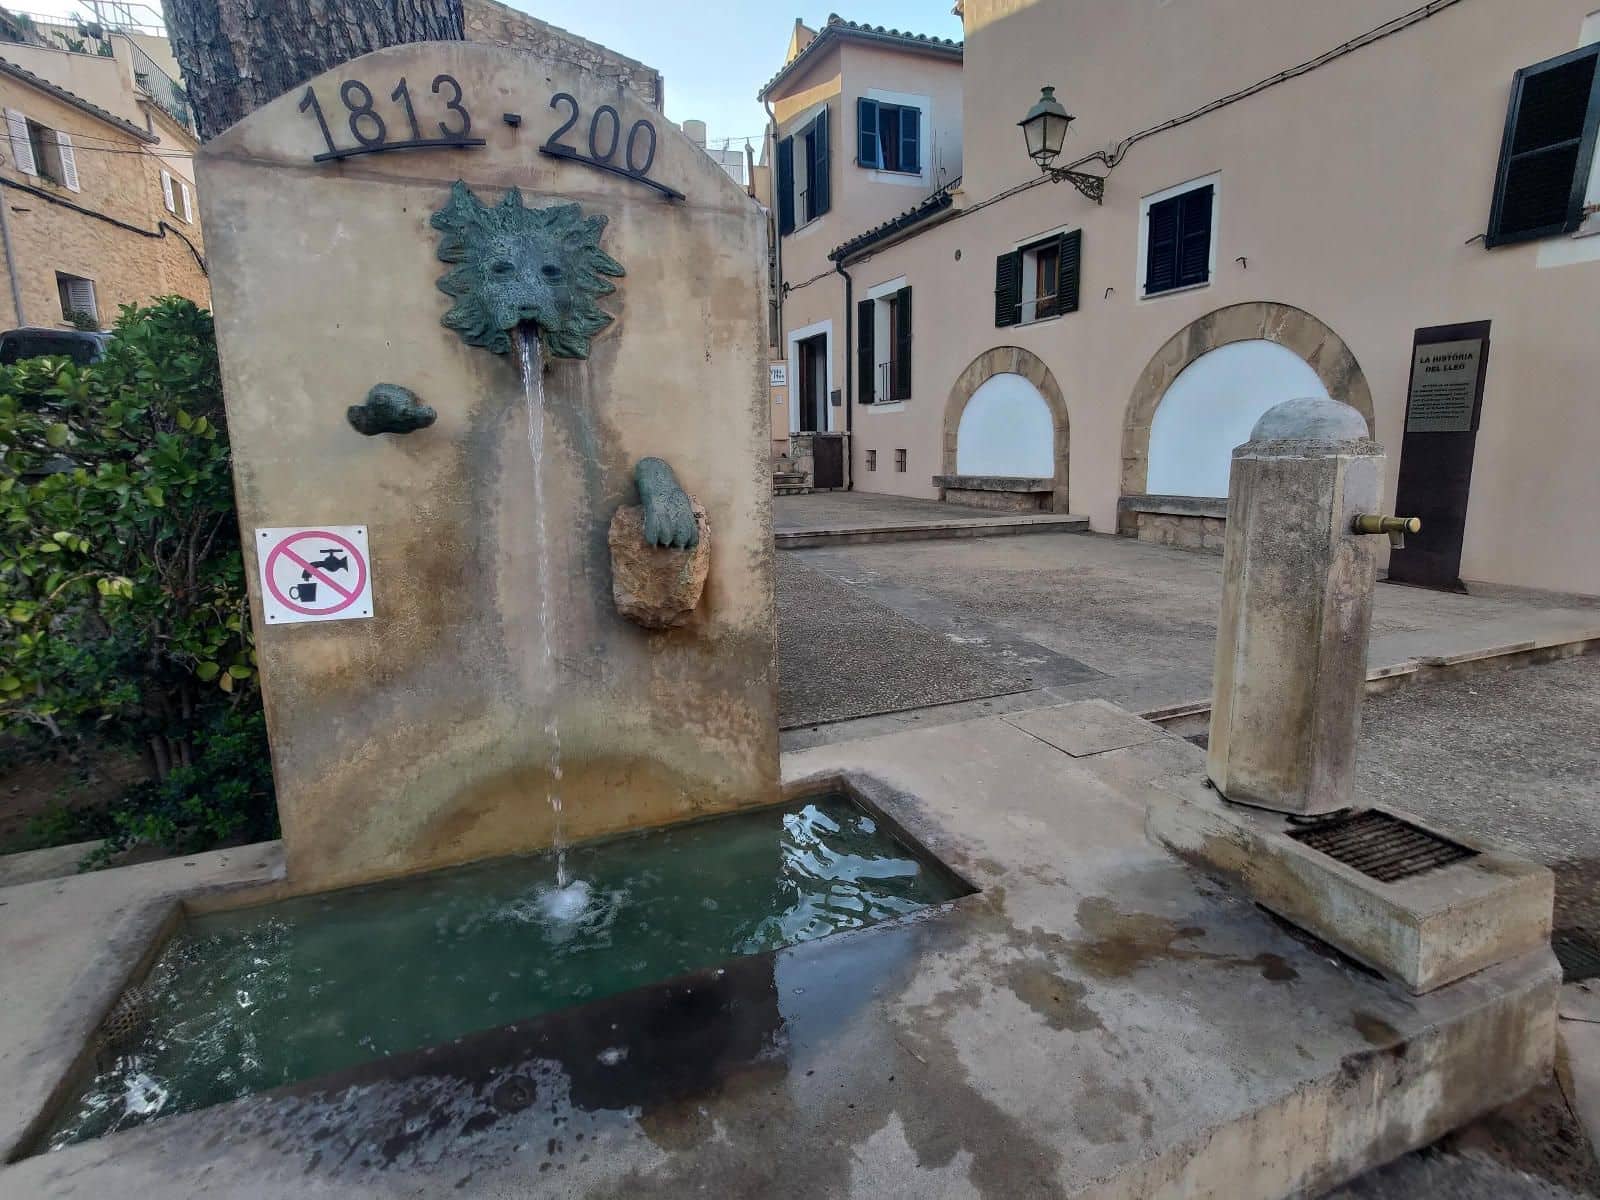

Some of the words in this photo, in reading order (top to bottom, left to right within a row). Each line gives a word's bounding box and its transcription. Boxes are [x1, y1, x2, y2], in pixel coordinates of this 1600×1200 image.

[299, 74, 471, 152] 1813
[546, 93, 656, 177] 200
[1420, 356, 1431, 364] LA
[1425, 365, 1441, 373] DEL
